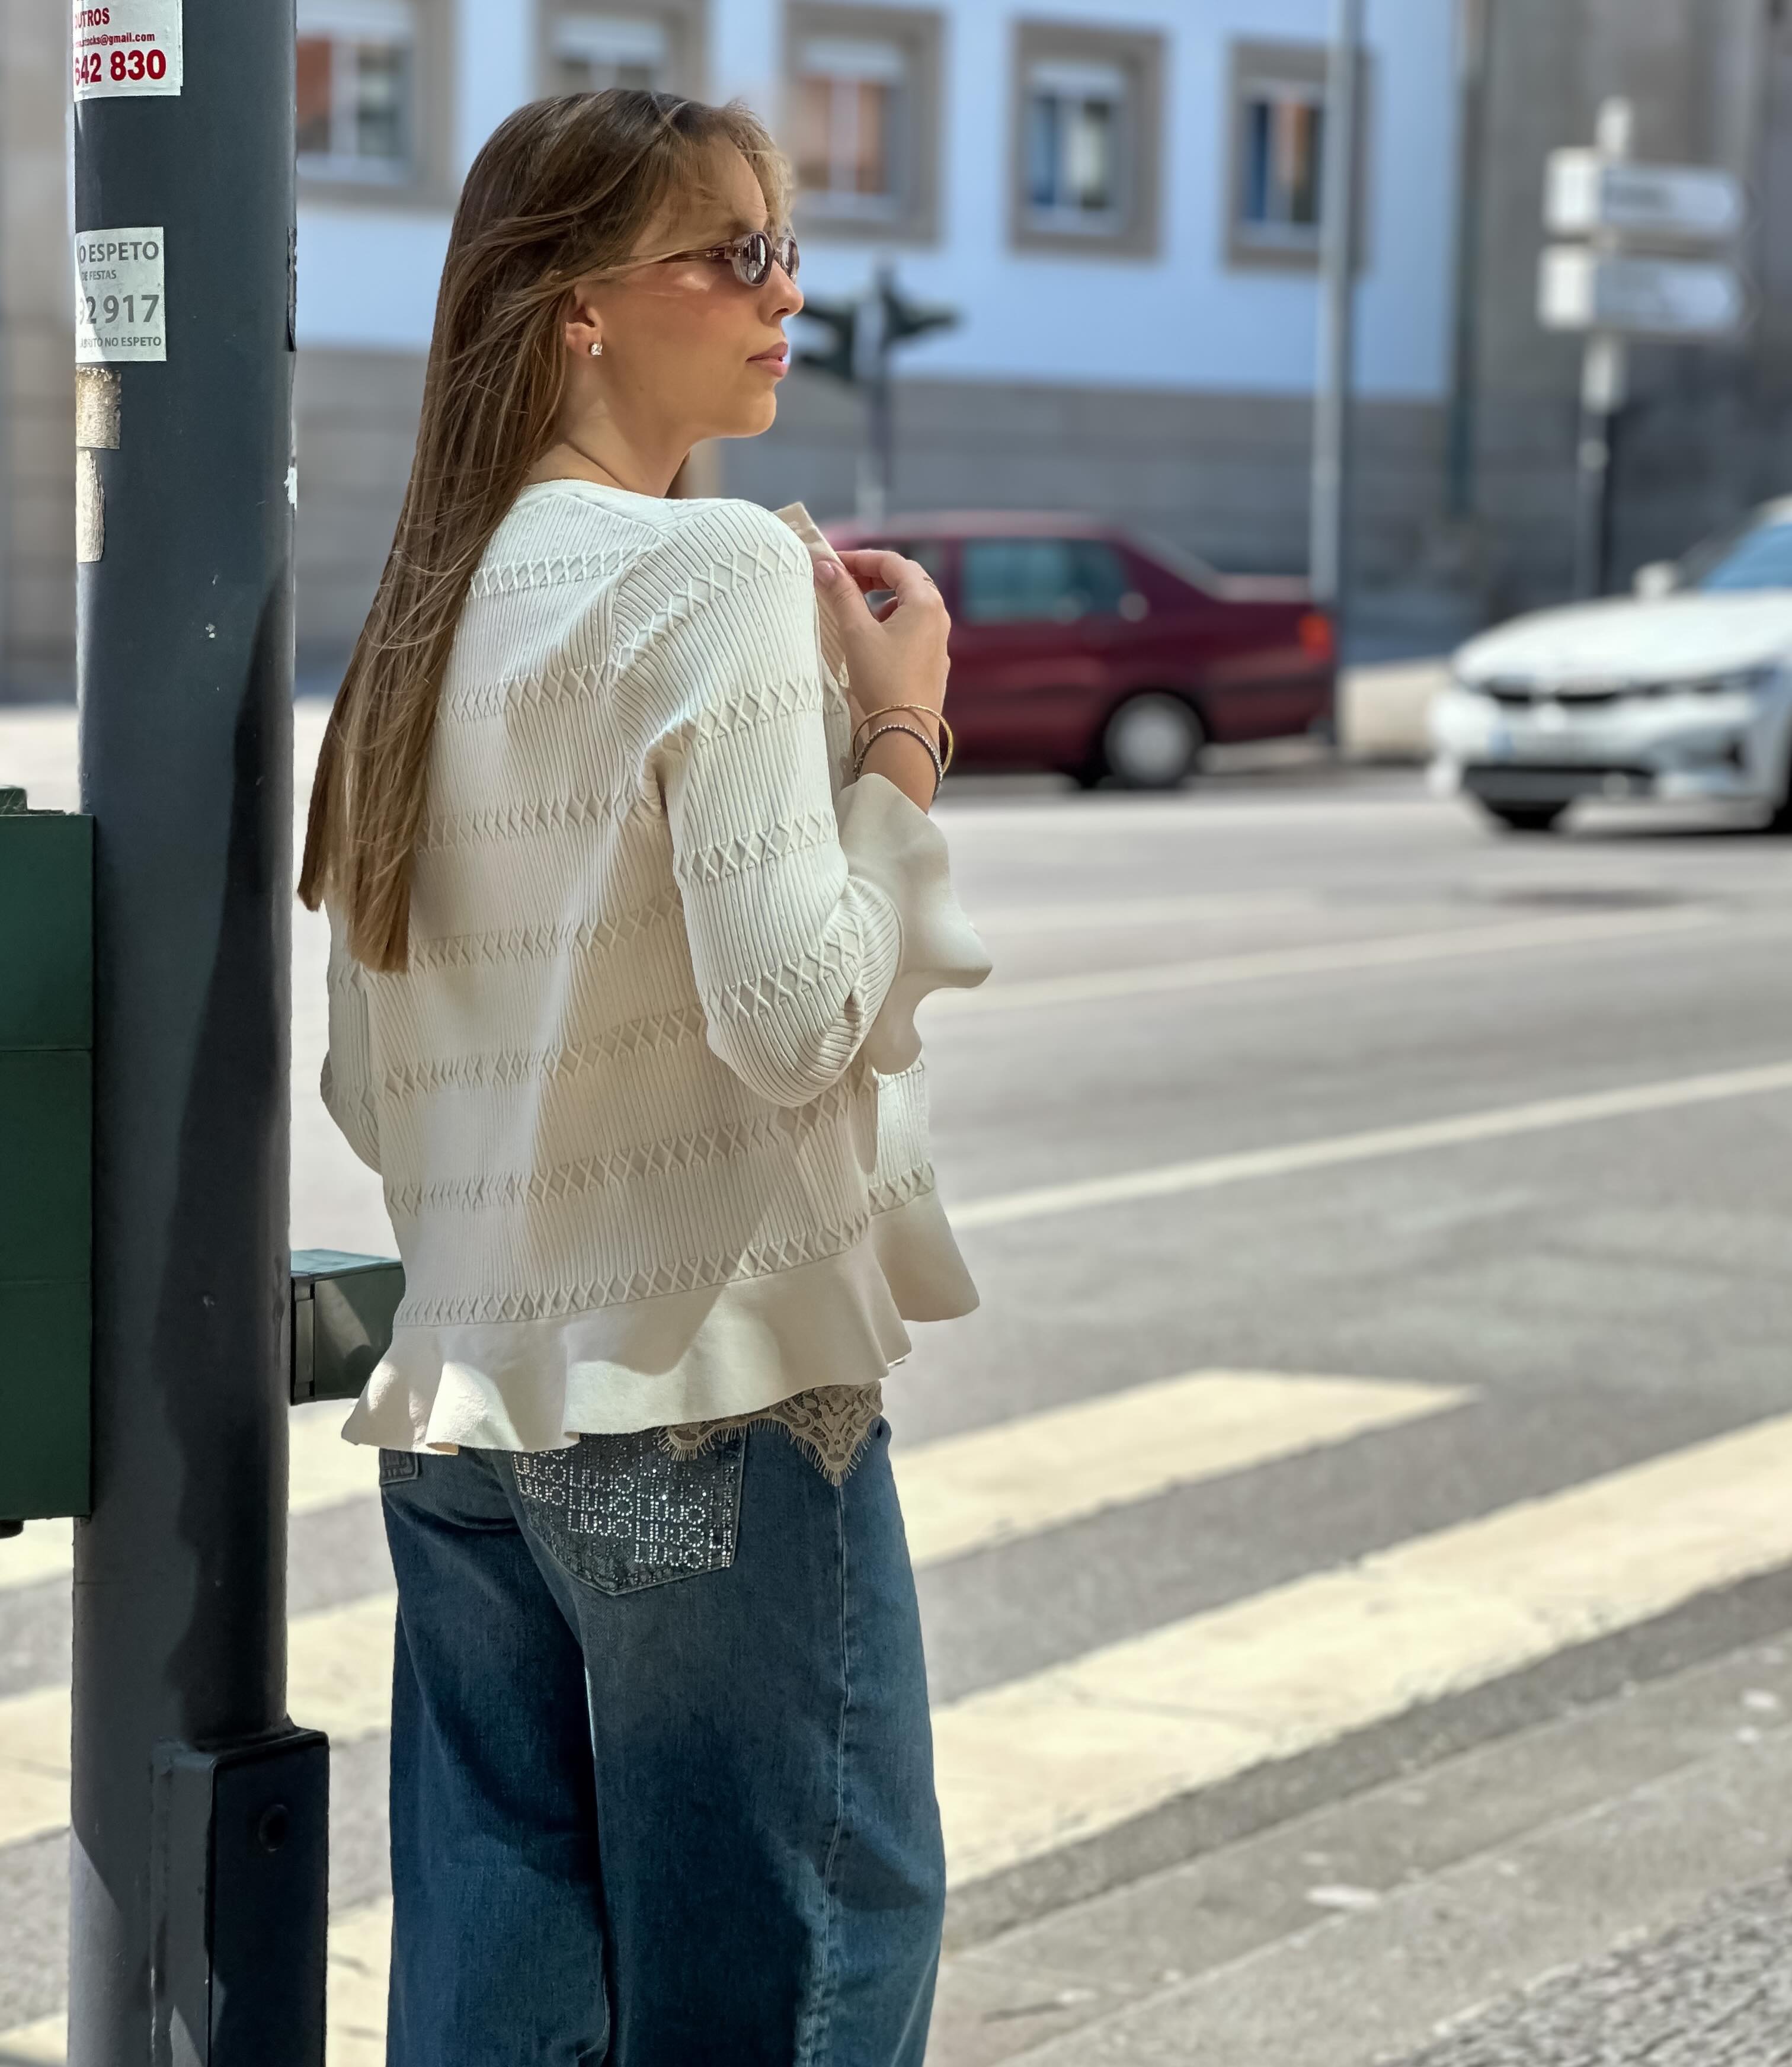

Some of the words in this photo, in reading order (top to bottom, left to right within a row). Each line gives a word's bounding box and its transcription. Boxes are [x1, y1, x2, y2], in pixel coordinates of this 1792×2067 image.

[75, 52, 102, 86] 642
[110, 49, 167, 81] 830
[89, 241, 159, 263] ESPETO
[89, 270, 117, 280] FESTAS
[103, 294, 159, 324] 917
[105, 337, 119, 347] NO
[121, 336, 162, 347] ESPETO
